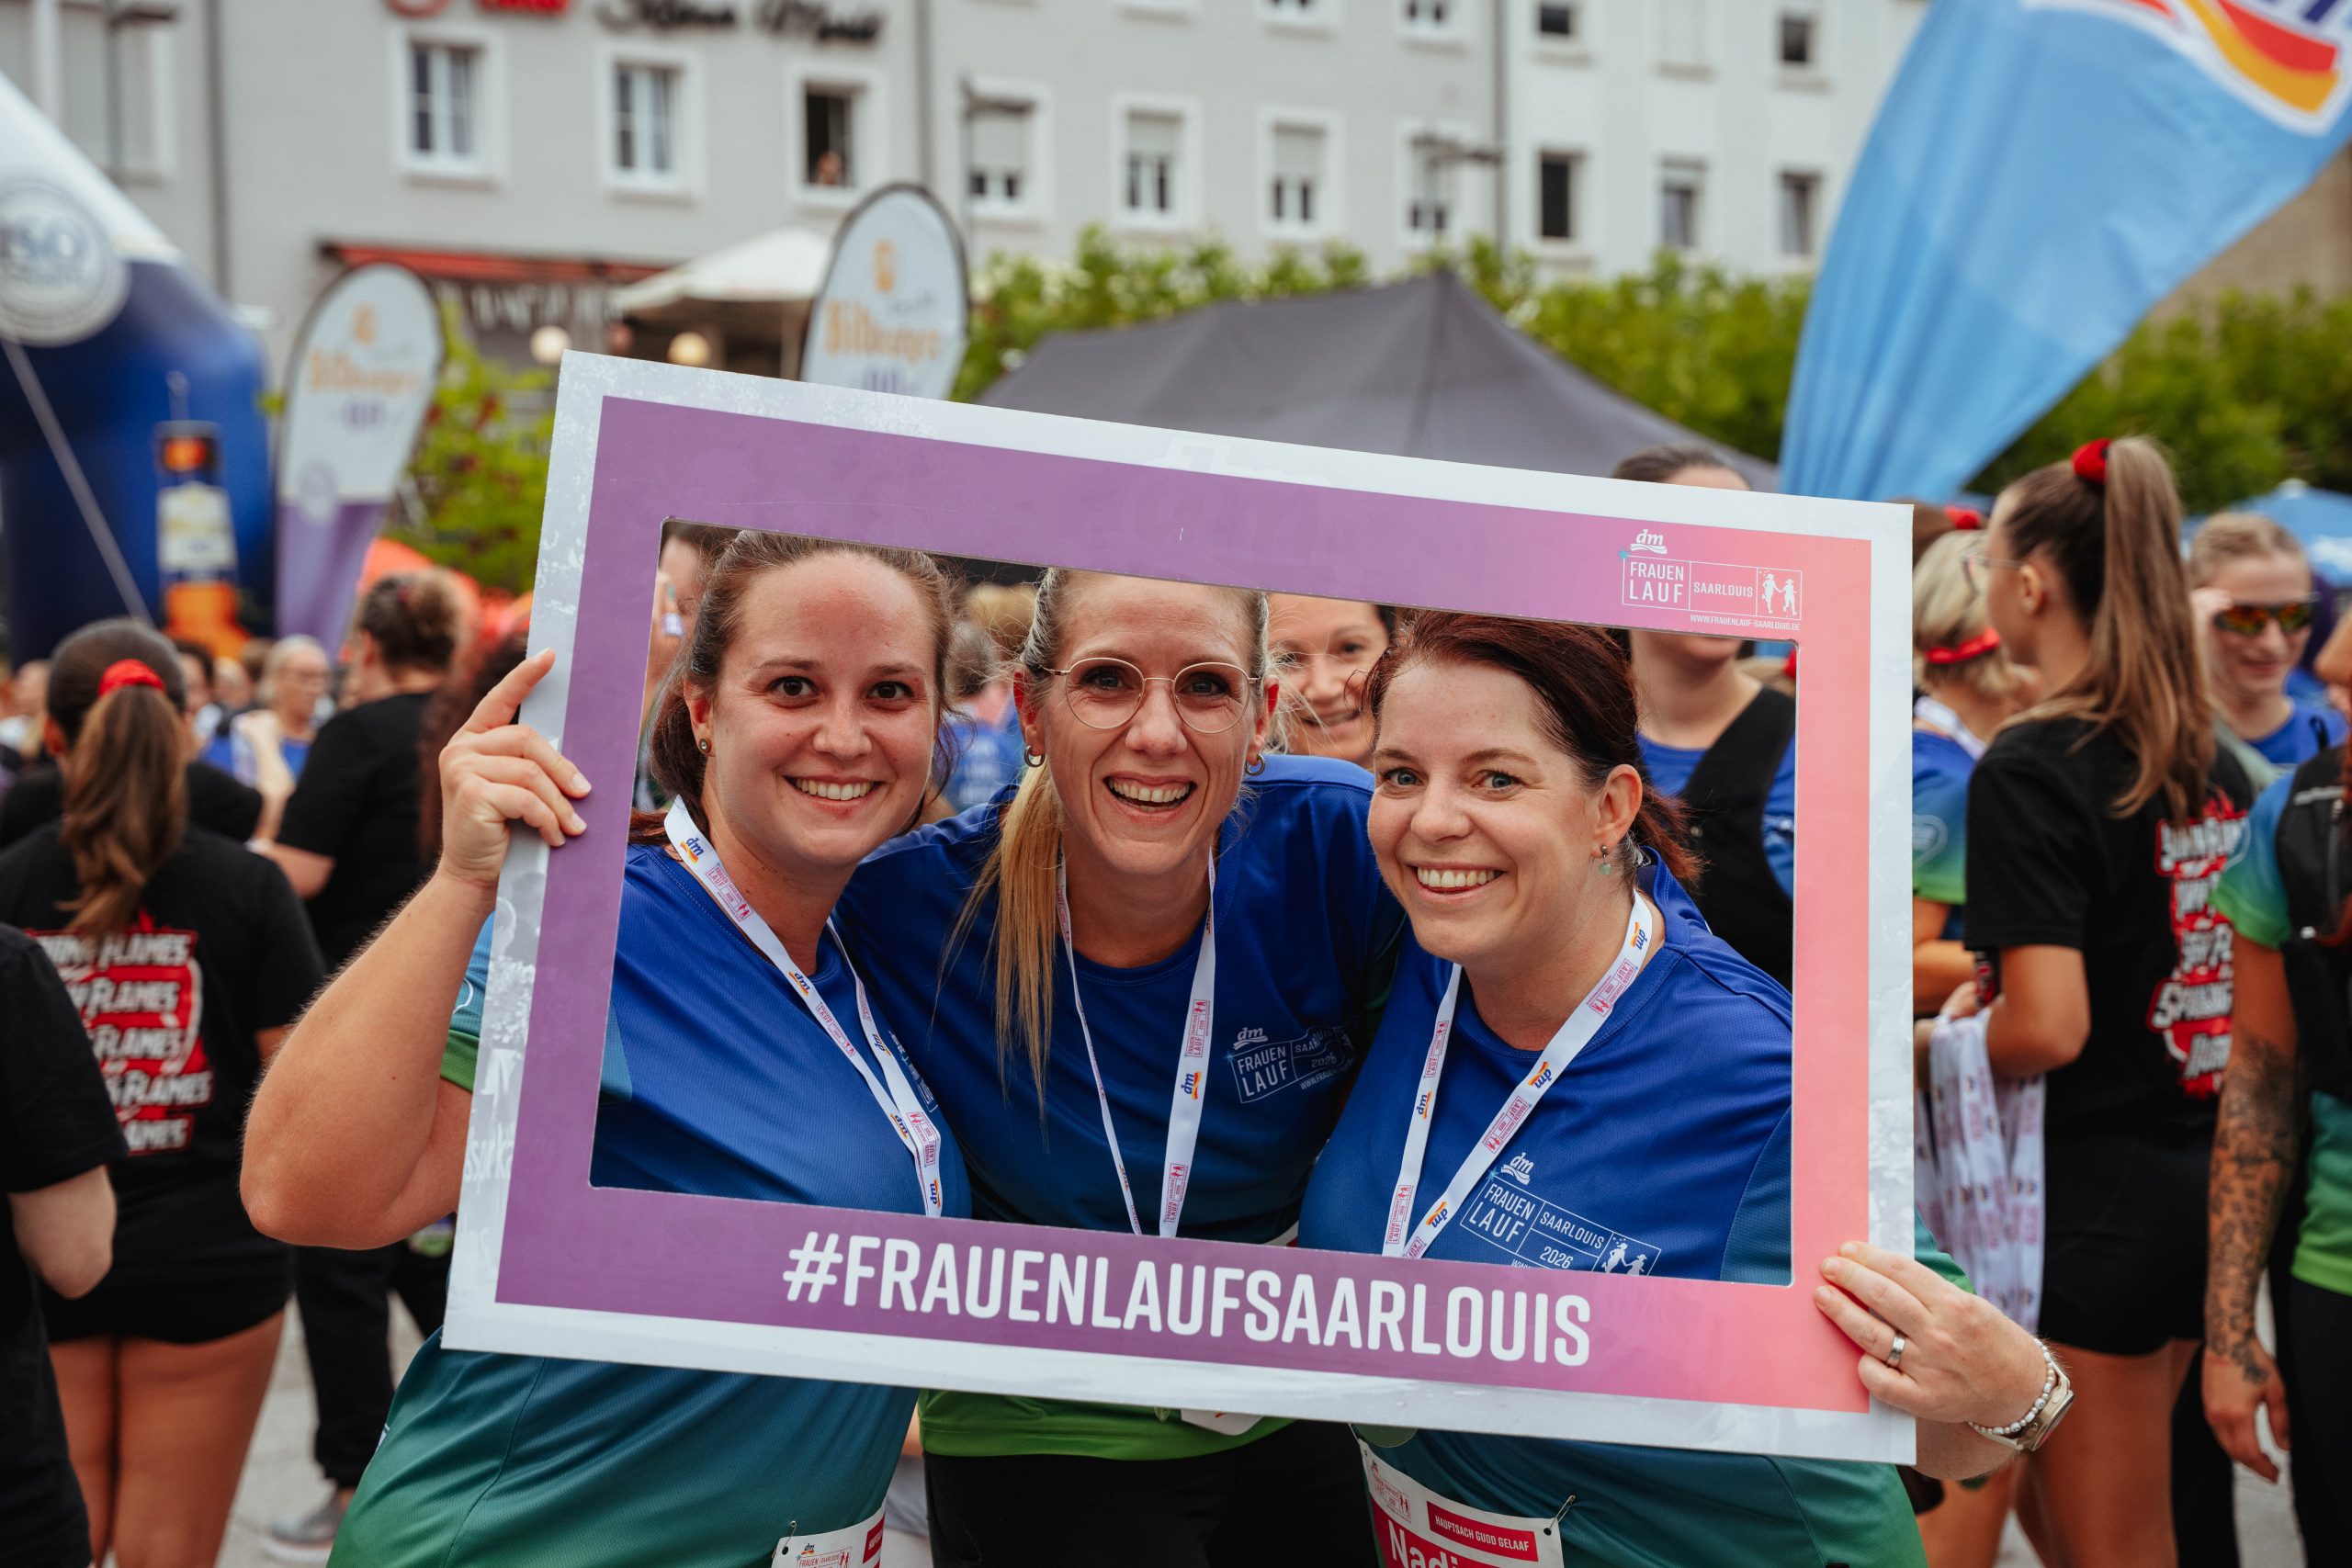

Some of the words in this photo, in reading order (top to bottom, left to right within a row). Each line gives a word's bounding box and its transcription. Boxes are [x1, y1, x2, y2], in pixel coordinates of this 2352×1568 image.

[1635, 528, 1664, 546] dm
[1629, 561, 1684, 581] FRAUEN
[1629, 580, 1684, 604] LAUF
[1693, 581, 1754, 598] SAARLOUIS
[1690, 614, 1801, 631] WWW.FRAUENLAUF-SAARLOUIS.DE
[685, 837, 705, 857] dm
[707, 870, 725, 888] LAUF
[715, 866, 730, 884] FRAUEN
[1635, 929, 1648, 951] dm
[1618, 961, 1630, 980] LAUF
[1623, 965, 1635, 986] FRAUEN
[794, 973, 810, 991] dm
[872, 1032, 886, 1052] dm
[1237, 1027, 1264, 1042] dm
[1193, 1037, 1204, 1055] LAUF
[1237, 1046, 1286, 1075] FRAUEN
[1311, 1052, 1337, 1068] 2026
[1181, 1073, 1195, 1095] dm
[1241, 1059, 1287, 1097] LAUF
[1534, 1068, 1553, 1089] dm
[1416, 1094, 1428, 1115] dm
[1509, 1099, 1523, 1118] LAUF
[1513, 1102, 1528, 1122] FRAUEN
[894, 1114, 909, 1134] dm
[1510, 1152, 1534, 1175] dm
[929, 1183, 938, 1205] dm
[1484, 1182, 1536, 1221] FRAUEN
[1430, 1208, 1448, 1228] dm
[1469, 1201, 1525, 1243] LAUF
[1393, 1223, 1401, 1242] LAUF
[1540, 1212, 1605, 1249] SAARLOUIS
[1539, 1246, 1574, 1269] 2026
[783, 1231, 1590, 1367] #FRAUENLAUFSAARLOUIS
[1434, 1515, 1475, 1540] HAUPTSACH
[1498, 1537, 1530, 1552] GELAAF
[803, 1543, 816, 1551] dm
[798, 1557, 819, 1568] FRAUEN
